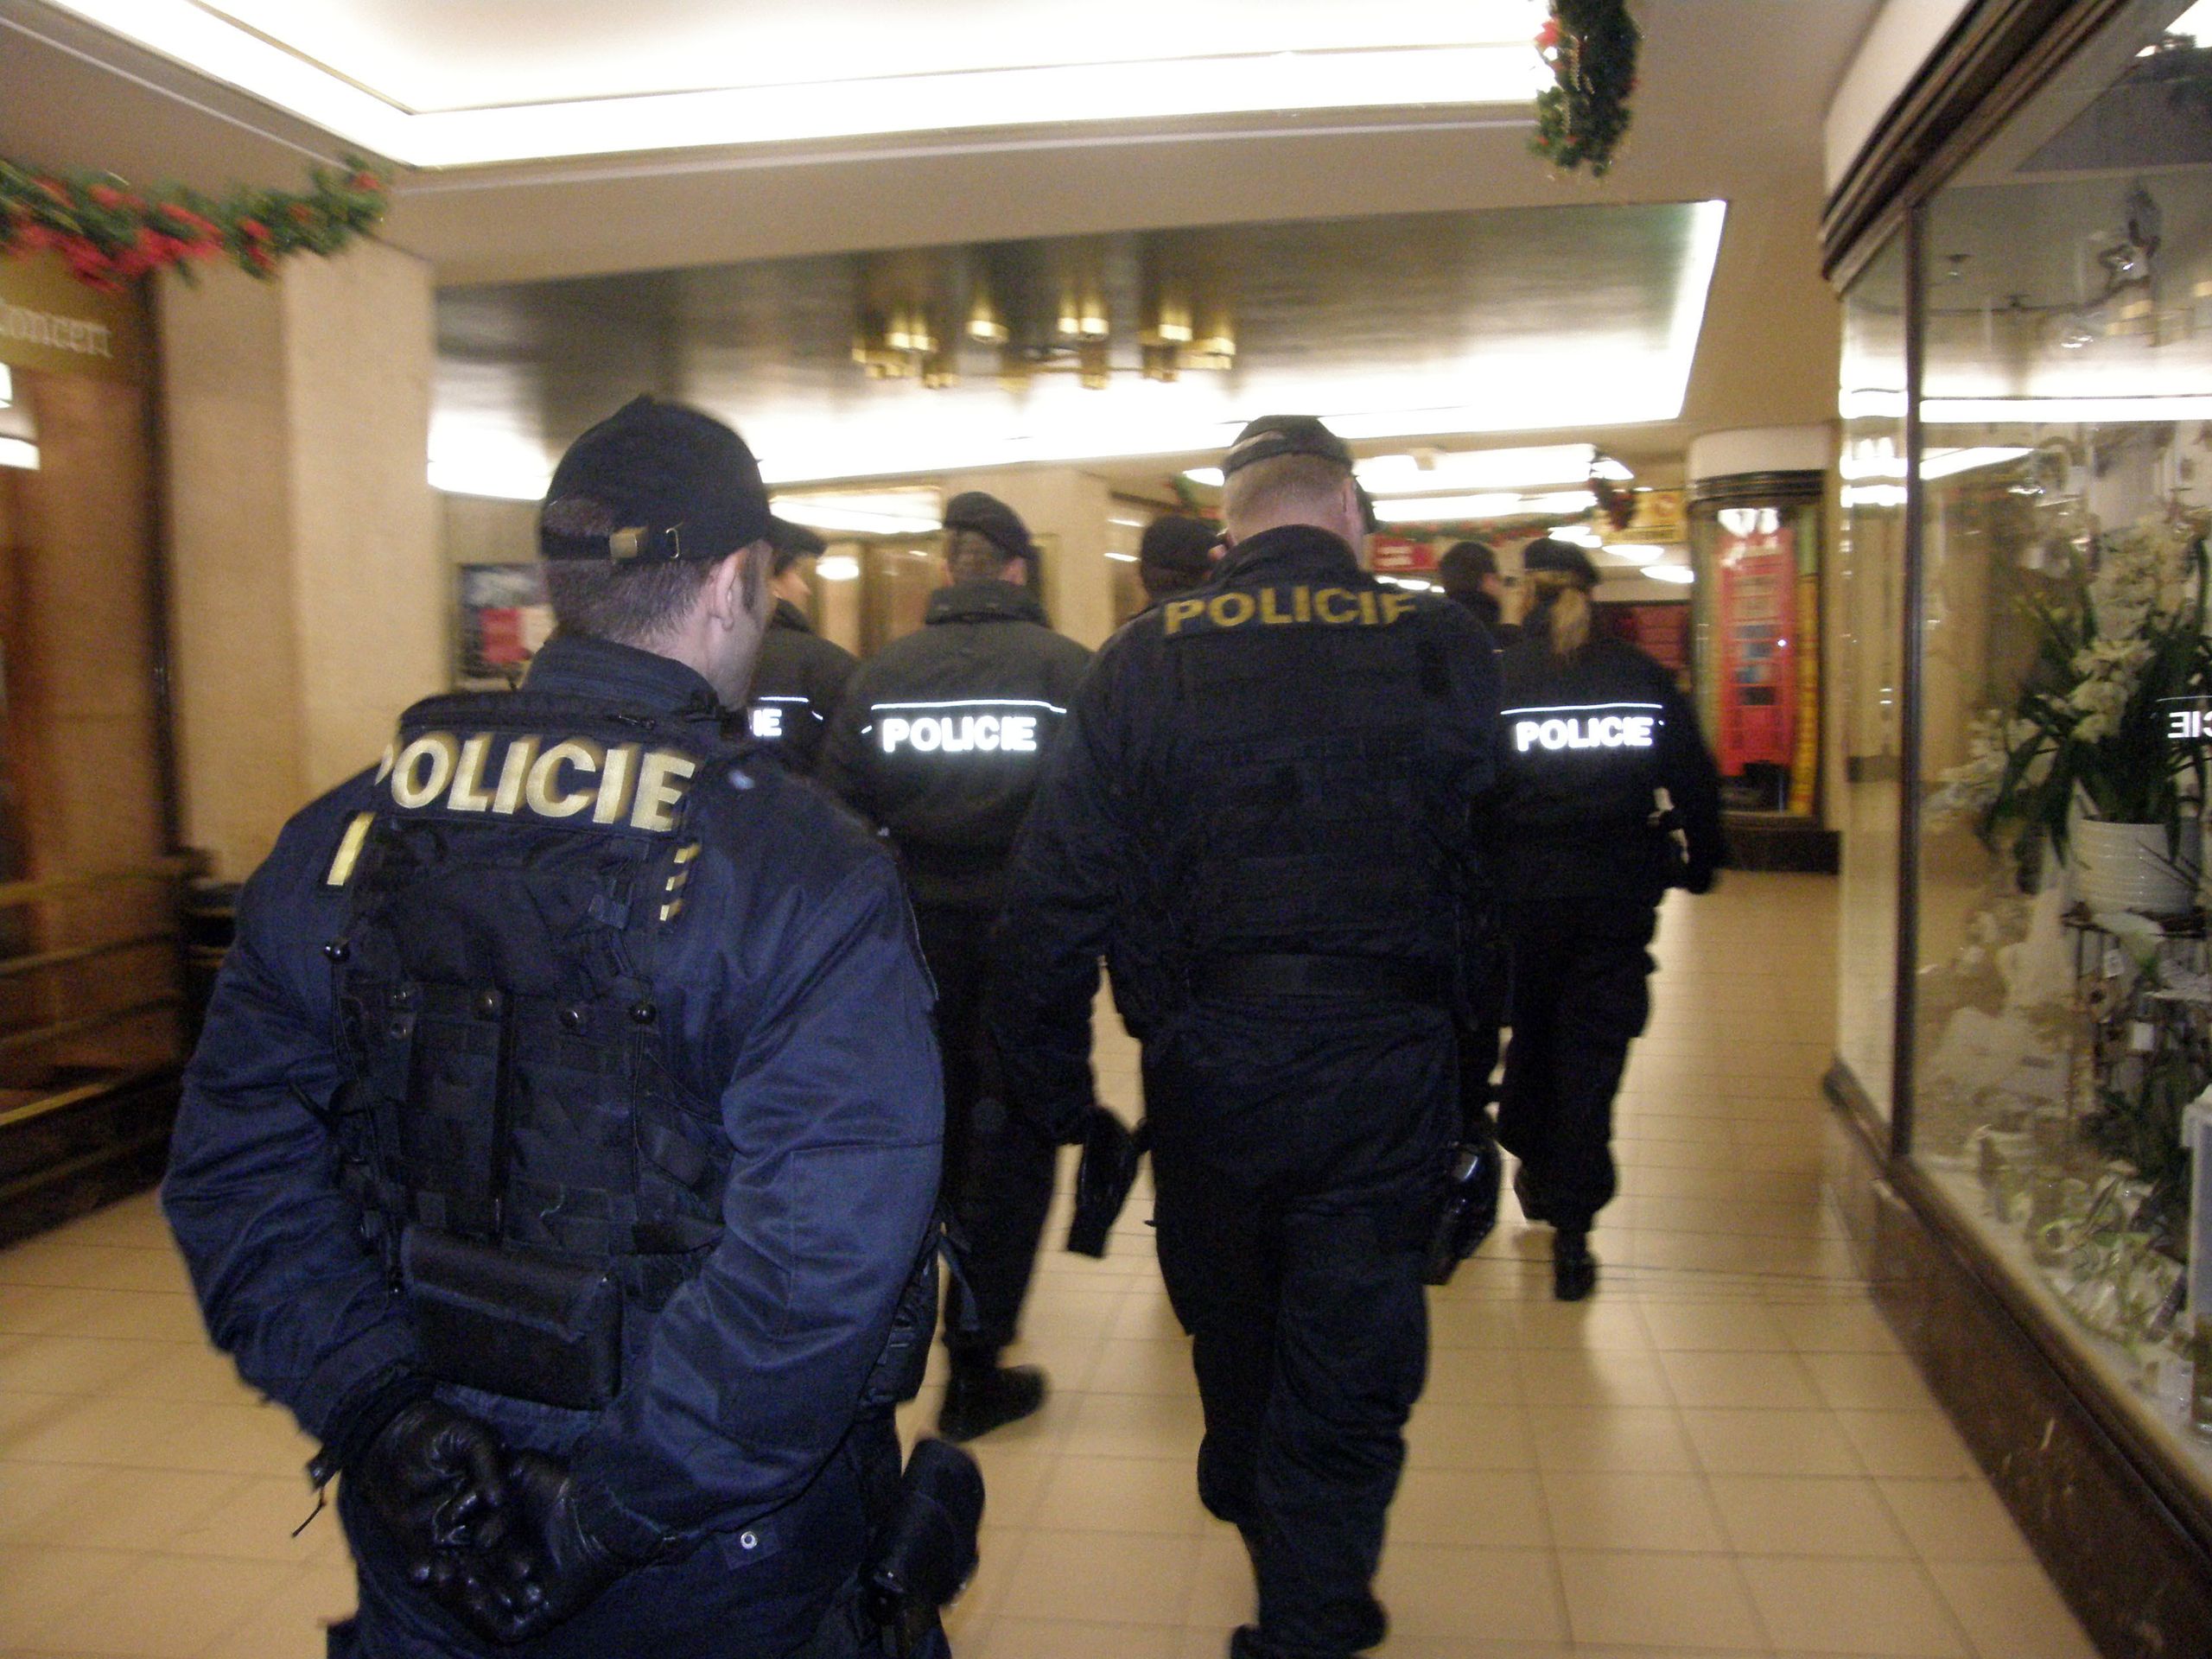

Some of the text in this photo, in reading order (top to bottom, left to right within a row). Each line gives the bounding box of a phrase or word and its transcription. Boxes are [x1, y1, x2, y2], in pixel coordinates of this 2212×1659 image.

[749, 709, 782, 736] IE
[882, 715, 1037, 753] POLICIE
[1516, 716, 1654, 752] POLICIE
